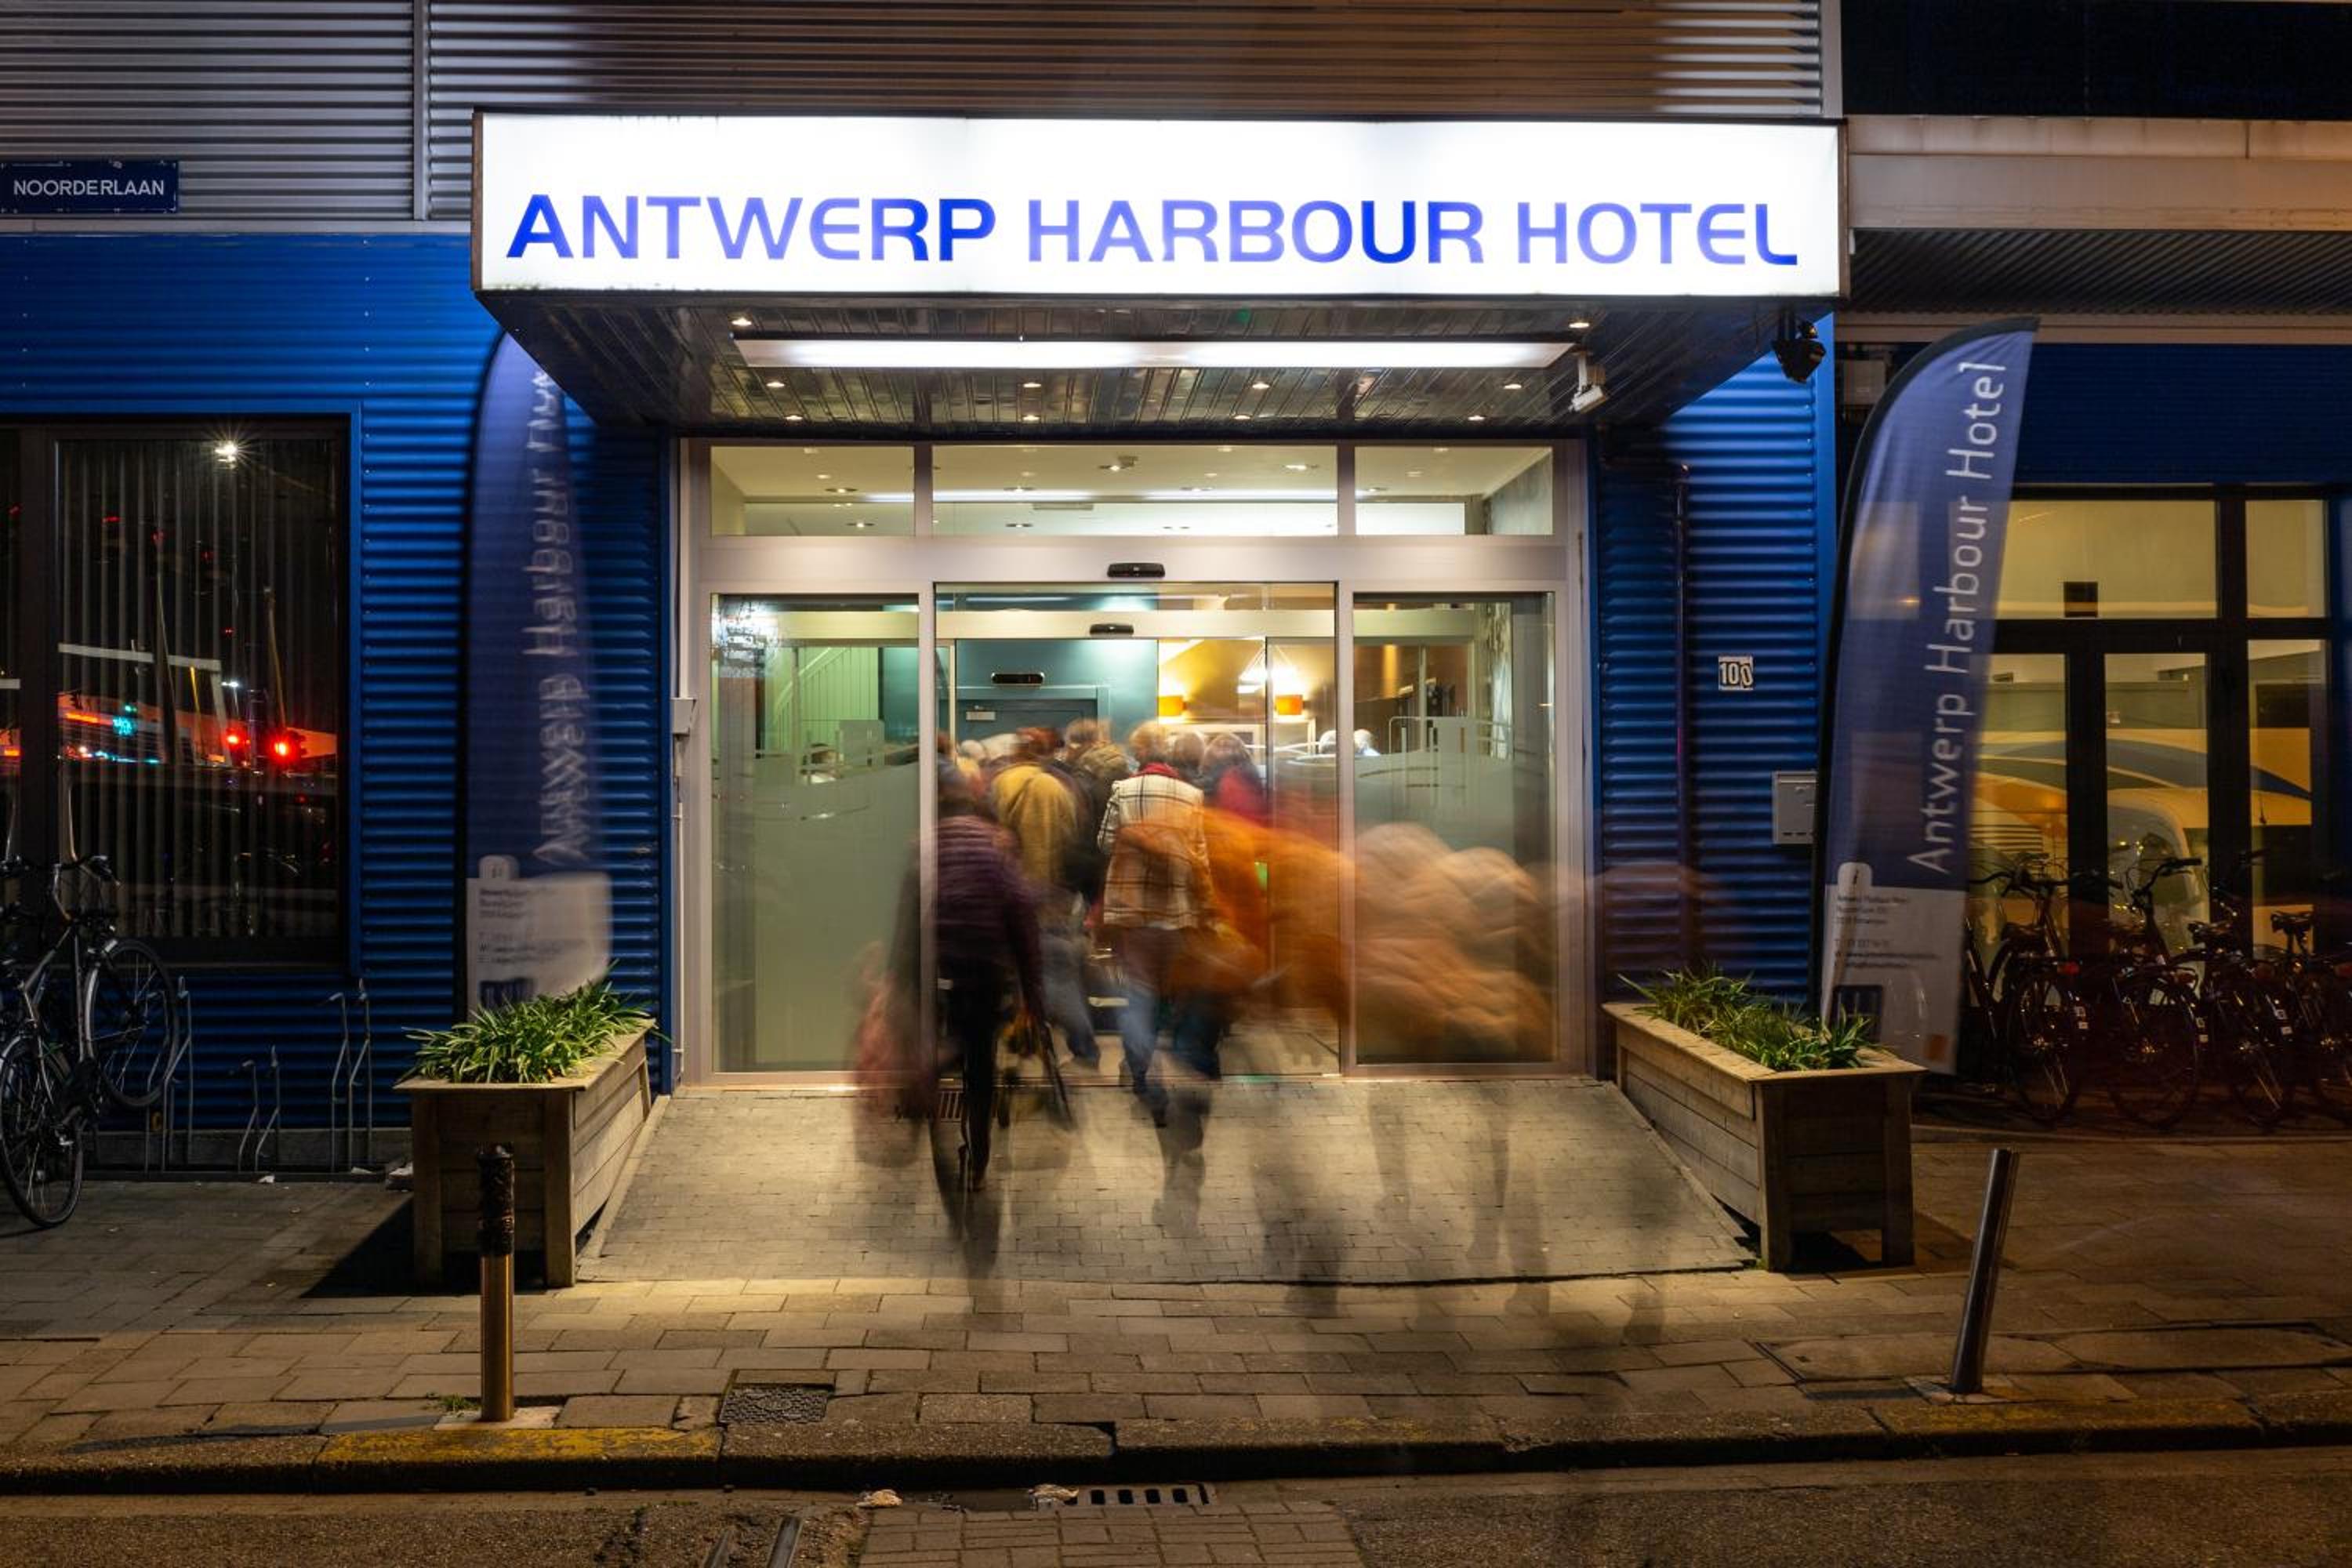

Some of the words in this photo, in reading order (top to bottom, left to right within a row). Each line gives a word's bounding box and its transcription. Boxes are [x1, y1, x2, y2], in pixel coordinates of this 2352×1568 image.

[13, 180, 164, 195] NOORDERLAAN
[506, 194, 996, 261] ANTWERP
[1028, 199, 1484, 263] HARBOUR
[1518, 201, 1798, 266] HOTEL
[1945, 361, 2007, 480] Hotel
[1923, 495, 1988, 673] Harbour
[1907, 693, 1977, 875] Antwerp
